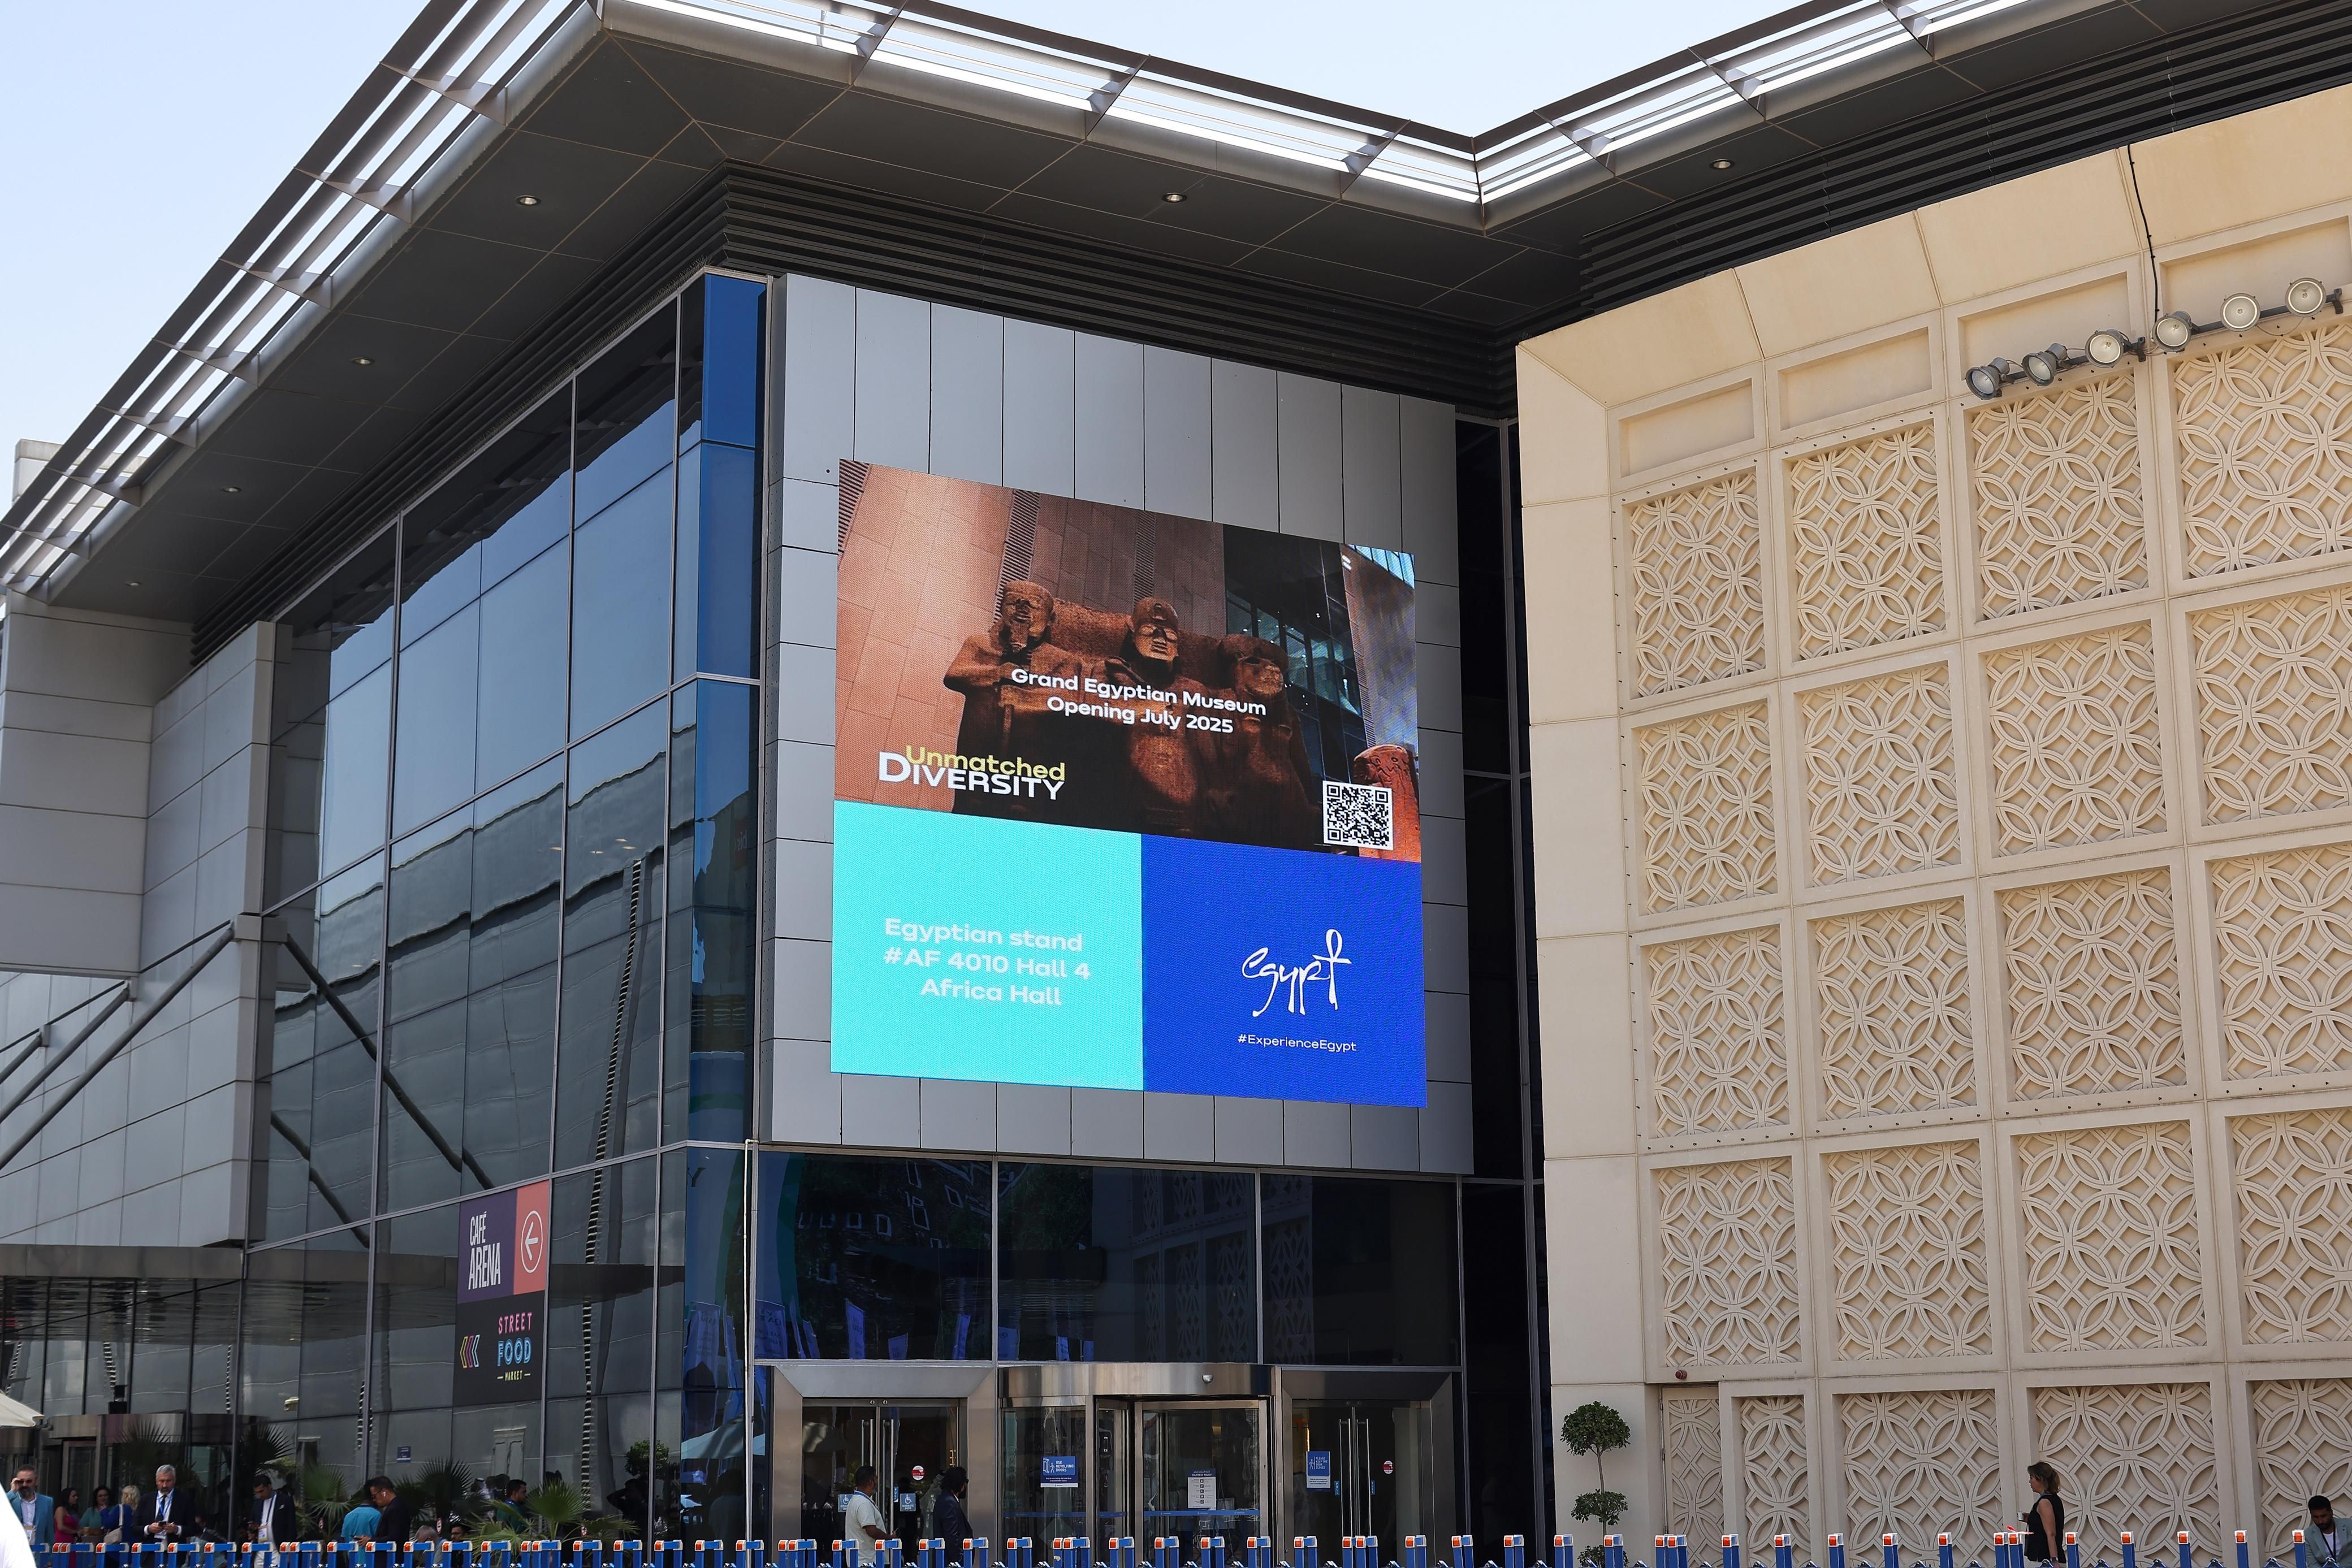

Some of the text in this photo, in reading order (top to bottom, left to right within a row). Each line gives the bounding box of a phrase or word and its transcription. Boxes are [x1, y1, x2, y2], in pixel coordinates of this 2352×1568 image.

[1011, 668, 1266, 716] Grand Egyptian Museum
[1047, 696, 1234, 734] Opening July 2025
[879, 751, 1065, 800] DIVERSITY
[906, 744, 1065, 781] Unmatched
[884, 917, 1083, 952] Egyptian stand
[883, 946, 1091, 980] #AF 4010 Hall 4
[920, 978, 1062, 1006] Africa Hall
[1237, 1034, 1357, 1052] #ExperienceEgypt
[470, 1210, 487, 1246] CAFÉ
[468, 1242, 501, 1290] ARENA
[498, 1312, 532, 1335] STREET
[497, 1337, 531, 1367] FOOD
[505, 1370, 522, 1381] MARKET
